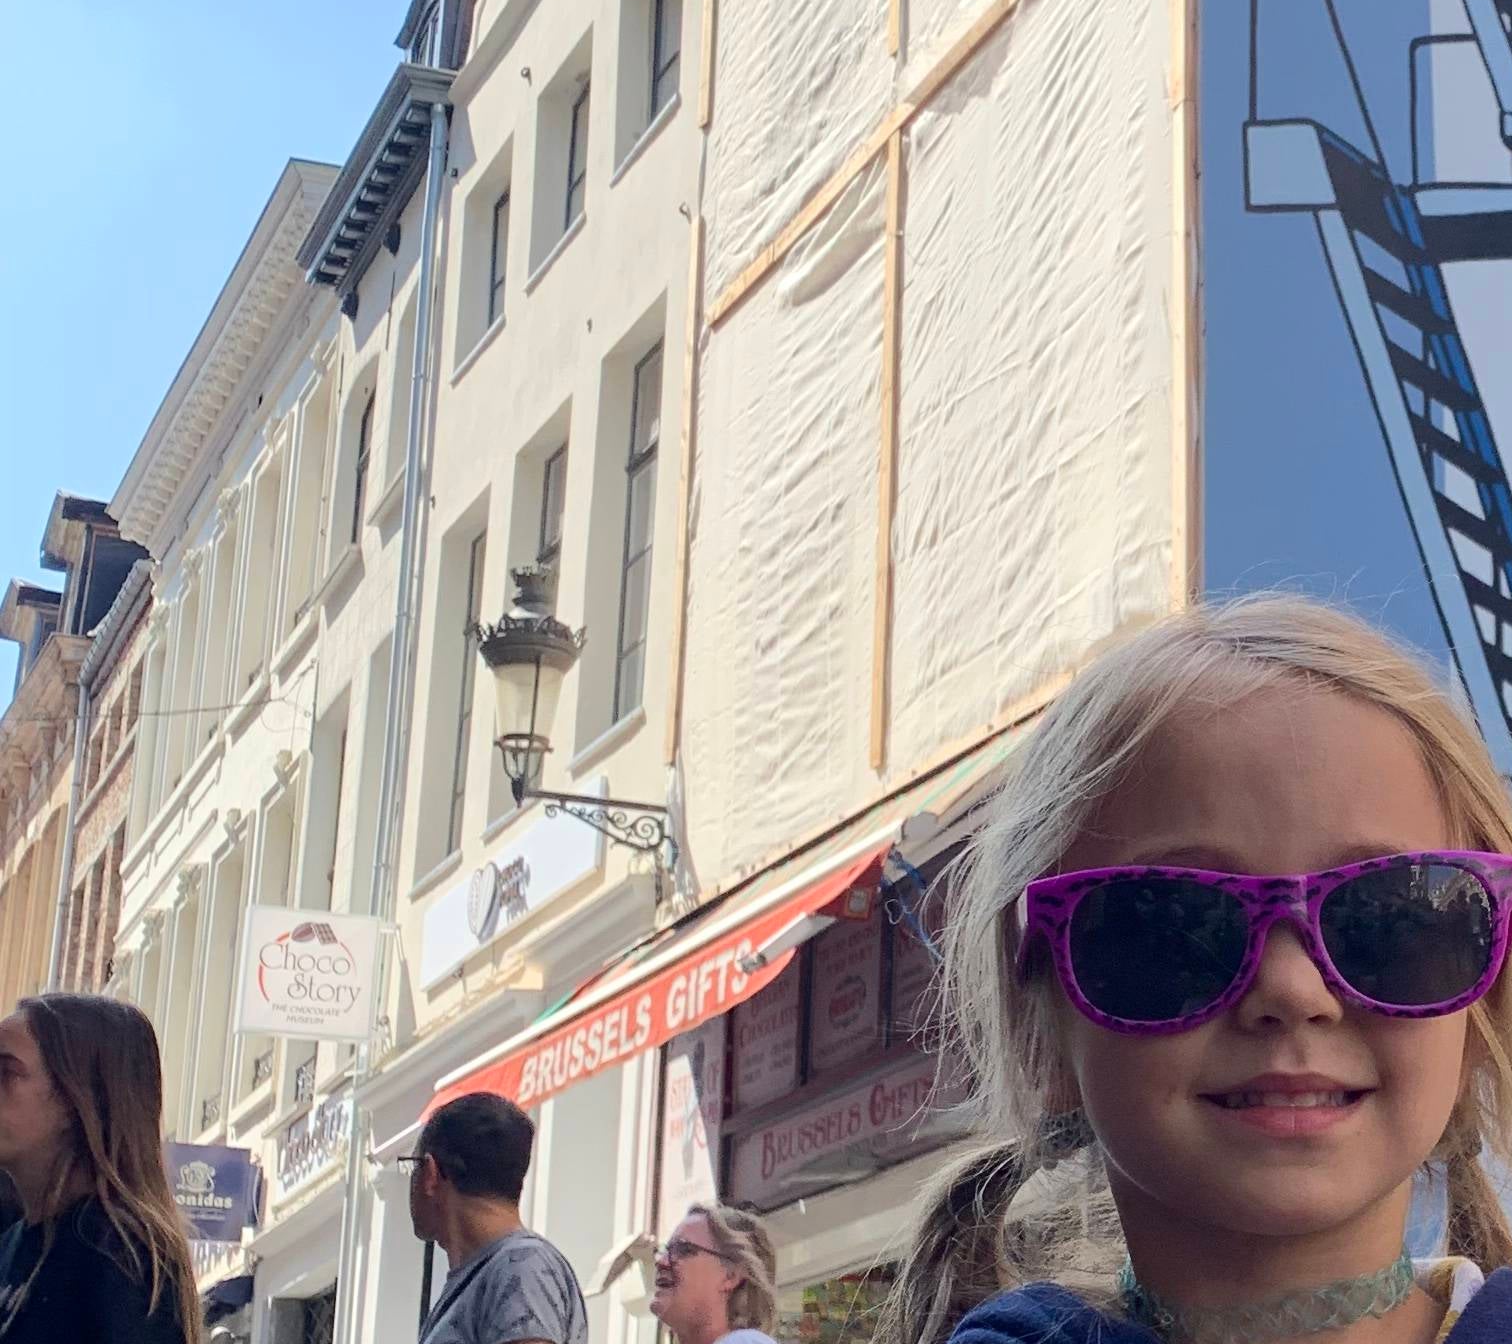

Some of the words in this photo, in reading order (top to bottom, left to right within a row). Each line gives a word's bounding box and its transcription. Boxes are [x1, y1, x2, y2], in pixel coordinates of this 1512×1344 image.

[259, 942, 350, 976] Choco
[287, 973, 361, 1014] Story
[272, 1003, 288, 1013] THE
[290, 1004, 340, 1017] CHOCOLATE
[286, 1015, 324, 1025] MUSEUM
[517, 994, 652, 1104] BRUSSELS
[665, 938, 754, 1030] GIFTS
[173, 1193, 233, 1210] onidas
